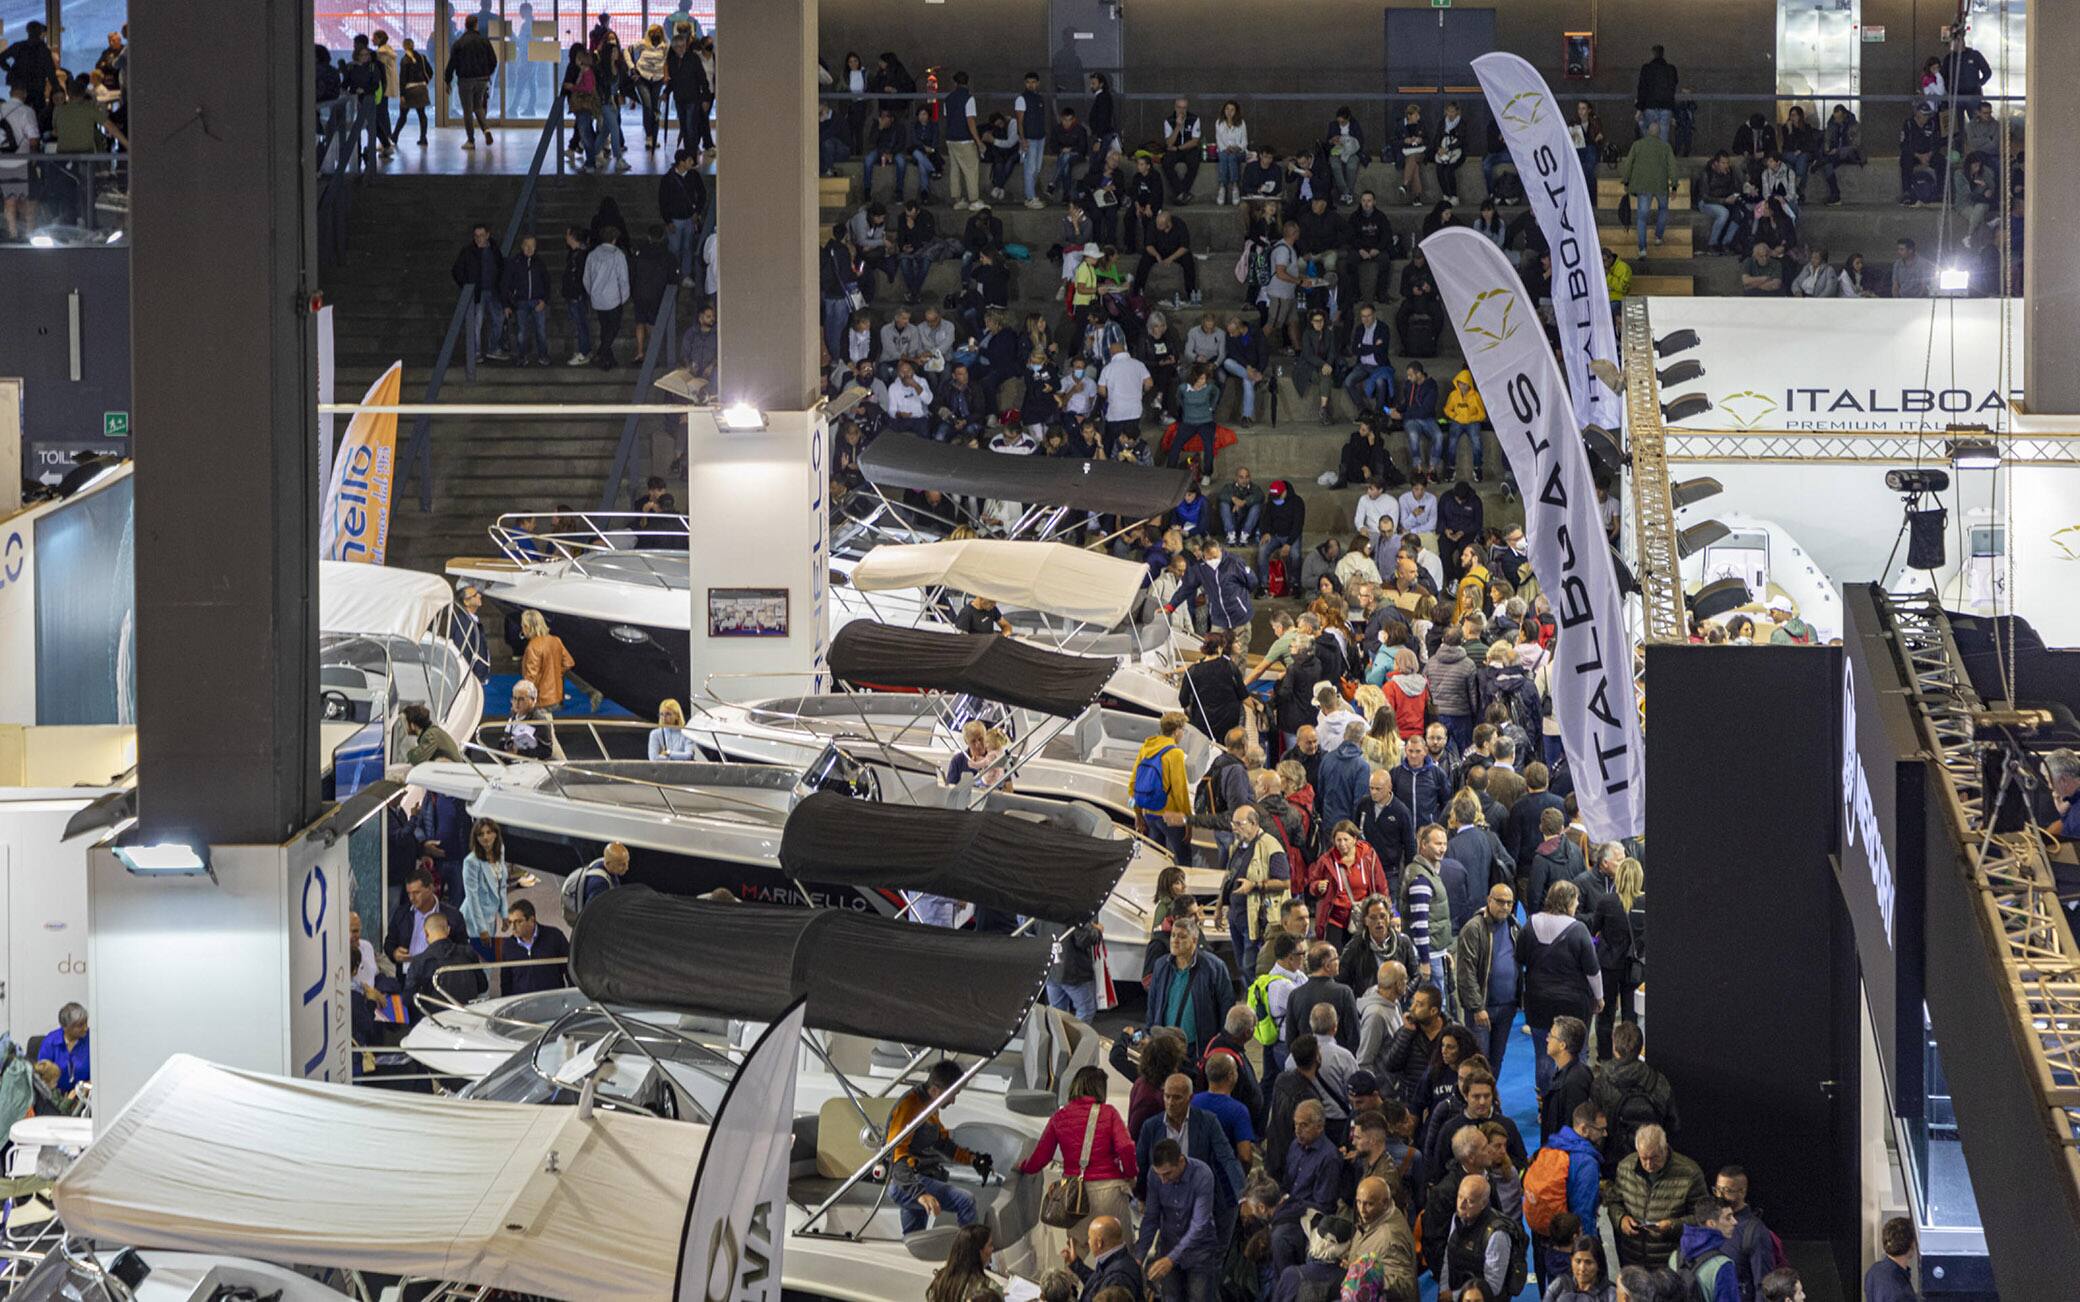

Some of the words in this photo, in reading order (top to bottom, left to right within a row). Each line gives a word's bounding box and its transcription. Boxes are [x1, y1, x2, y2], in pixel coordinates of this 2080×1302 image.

[1534, 144, 1600, 402] ITALBOATS
[1786, 421, 1887, 430] PREMIUM
[38, 450, 118, 464] TOILE
[372, 476, 388, 504] dal
[742, 883, 866, 912] MARINELLO
[302, 865, 330, 1082] LLO
[334, 966, 346, 1035] 1973
